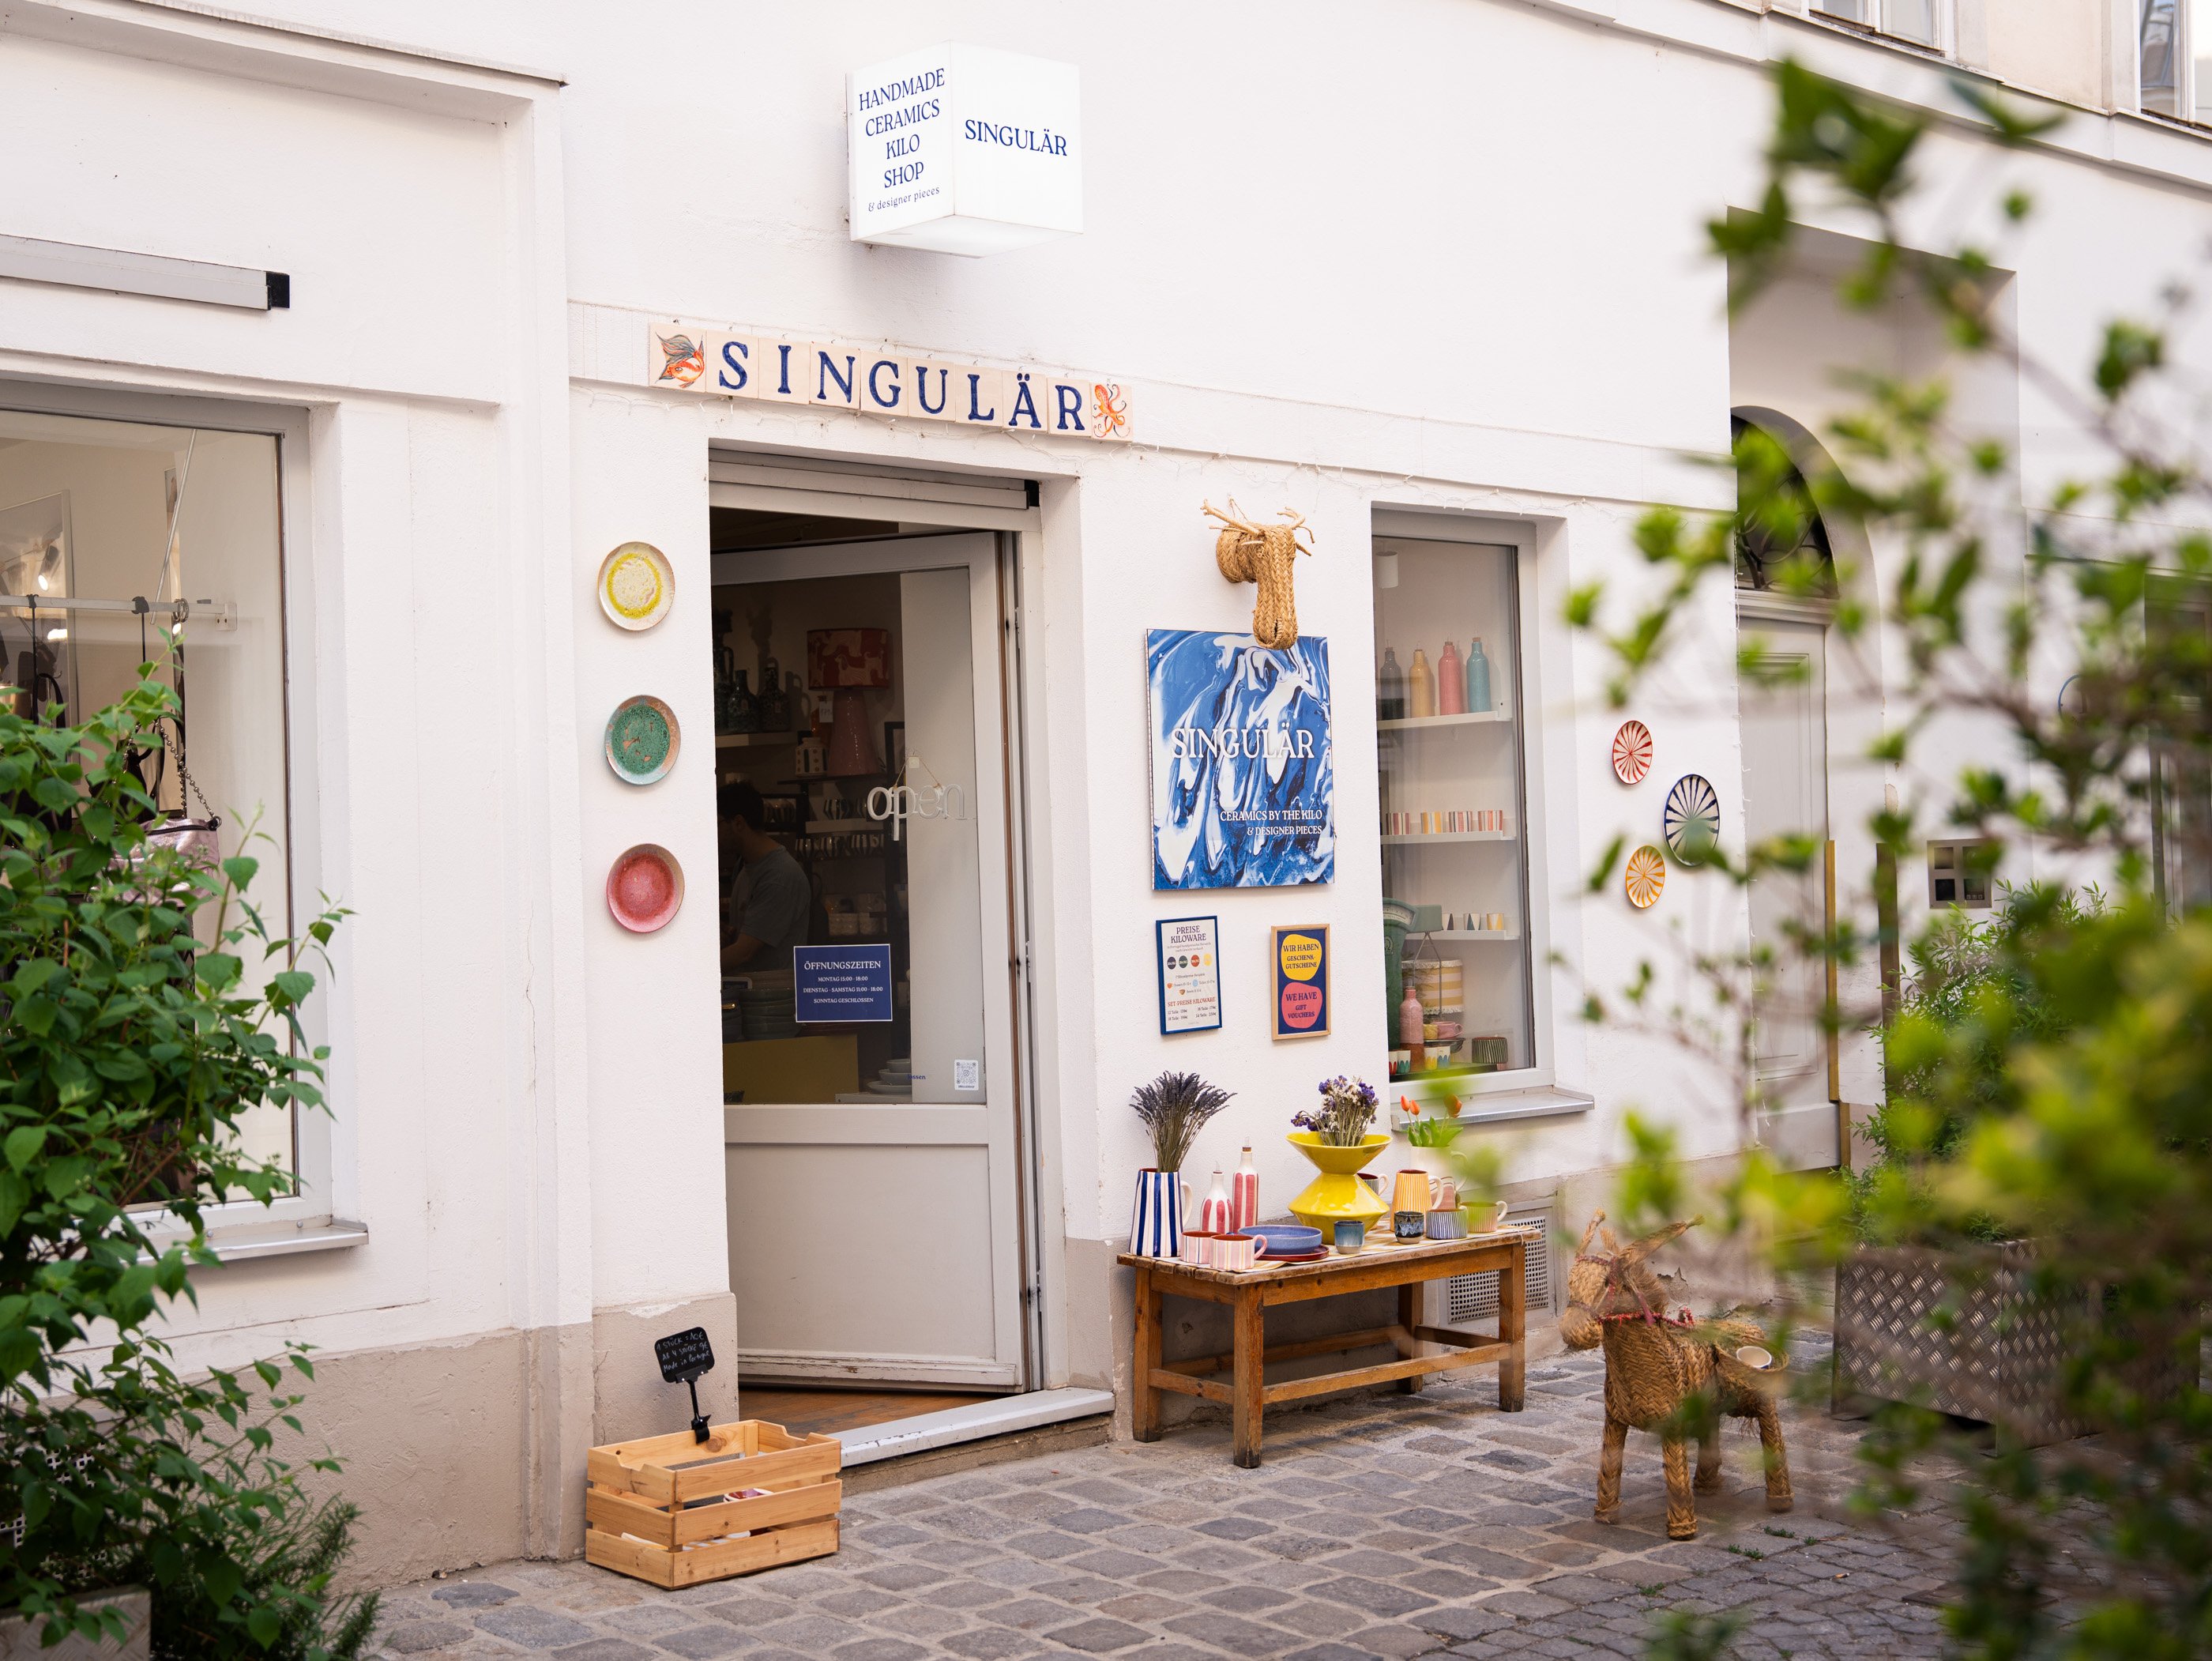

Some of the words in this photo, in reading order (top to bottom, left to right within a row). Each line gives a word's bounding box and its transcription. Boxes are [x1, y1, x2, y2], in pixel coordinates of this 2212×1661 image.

[859, 68, 946, 111] HANDMADE
[865, 99, 940, 137] CERAMICS
[886, 134, 920, 160] KILO
[965, 119, 1067, 156] SINGULÄR
[884, 161, 924, 188] SHOP
[868, 202, 875, 212] &
[877, 194, 912, 210] designer
[913, 186, 940, 202] pieces
[718, 340, 1085, 431] SINGULÄR
[1170, 722, 1315, 759] SINGULÄR
[867, 784, 965, 841] open
[1220, 811, 1267, 821] CERAMICS
[1269, 811, 1281, 820] BY
[1282, 810, 1300, 820] THE
[1301, 809, 1322, 819] KILO
[1255, 827, 1294, 835] DESIGNER
[1296, 826, 1322, 834] PIECES
[1171, 933, 1206, 943] KILOWARE
[1176, 925, 1200, 934] PREISE
[804, 961, 881, 970] ÖFFNUNGSZEITEN
[1298, 992, 1317, 1000] HAVE
[663, 1337, 683, 1348] STÜCK
[664, 1362, 678, 1373] Made
[688, 1350, 709, 1362] Portugal
